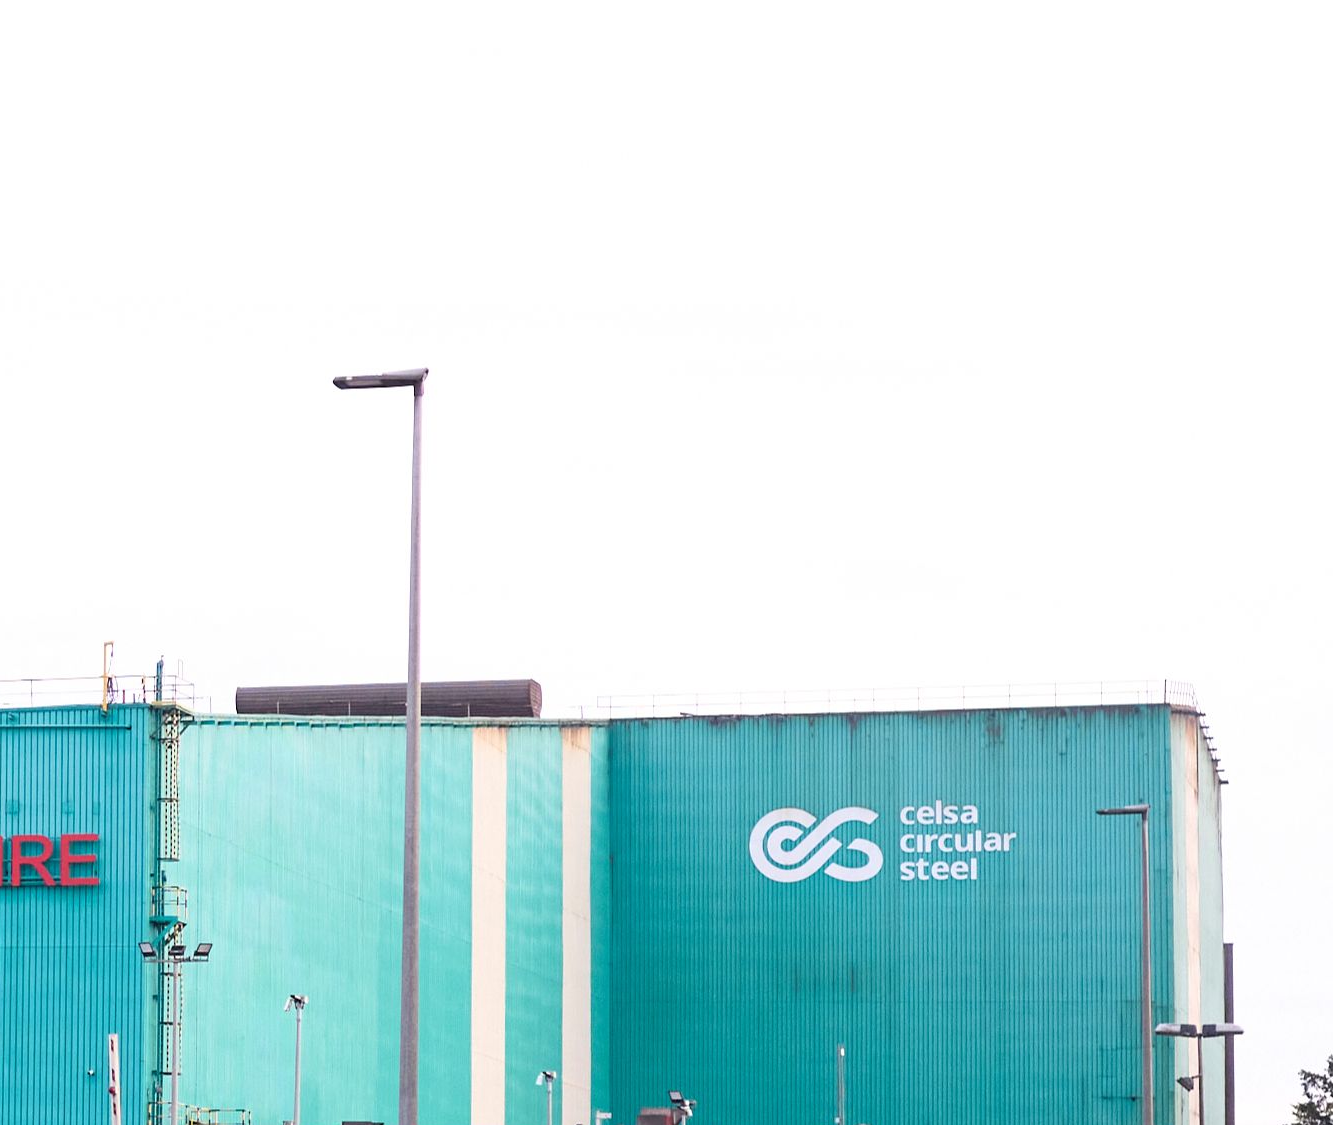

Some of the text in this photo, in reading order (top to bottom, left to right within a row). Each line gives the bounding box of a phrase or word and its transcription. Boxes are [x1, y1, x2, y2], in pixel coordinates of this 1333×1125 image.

[900, 799, 979, 825] celsa
[900, 829, 1017, 853] circular
[900, 857, 978, 881] steel
